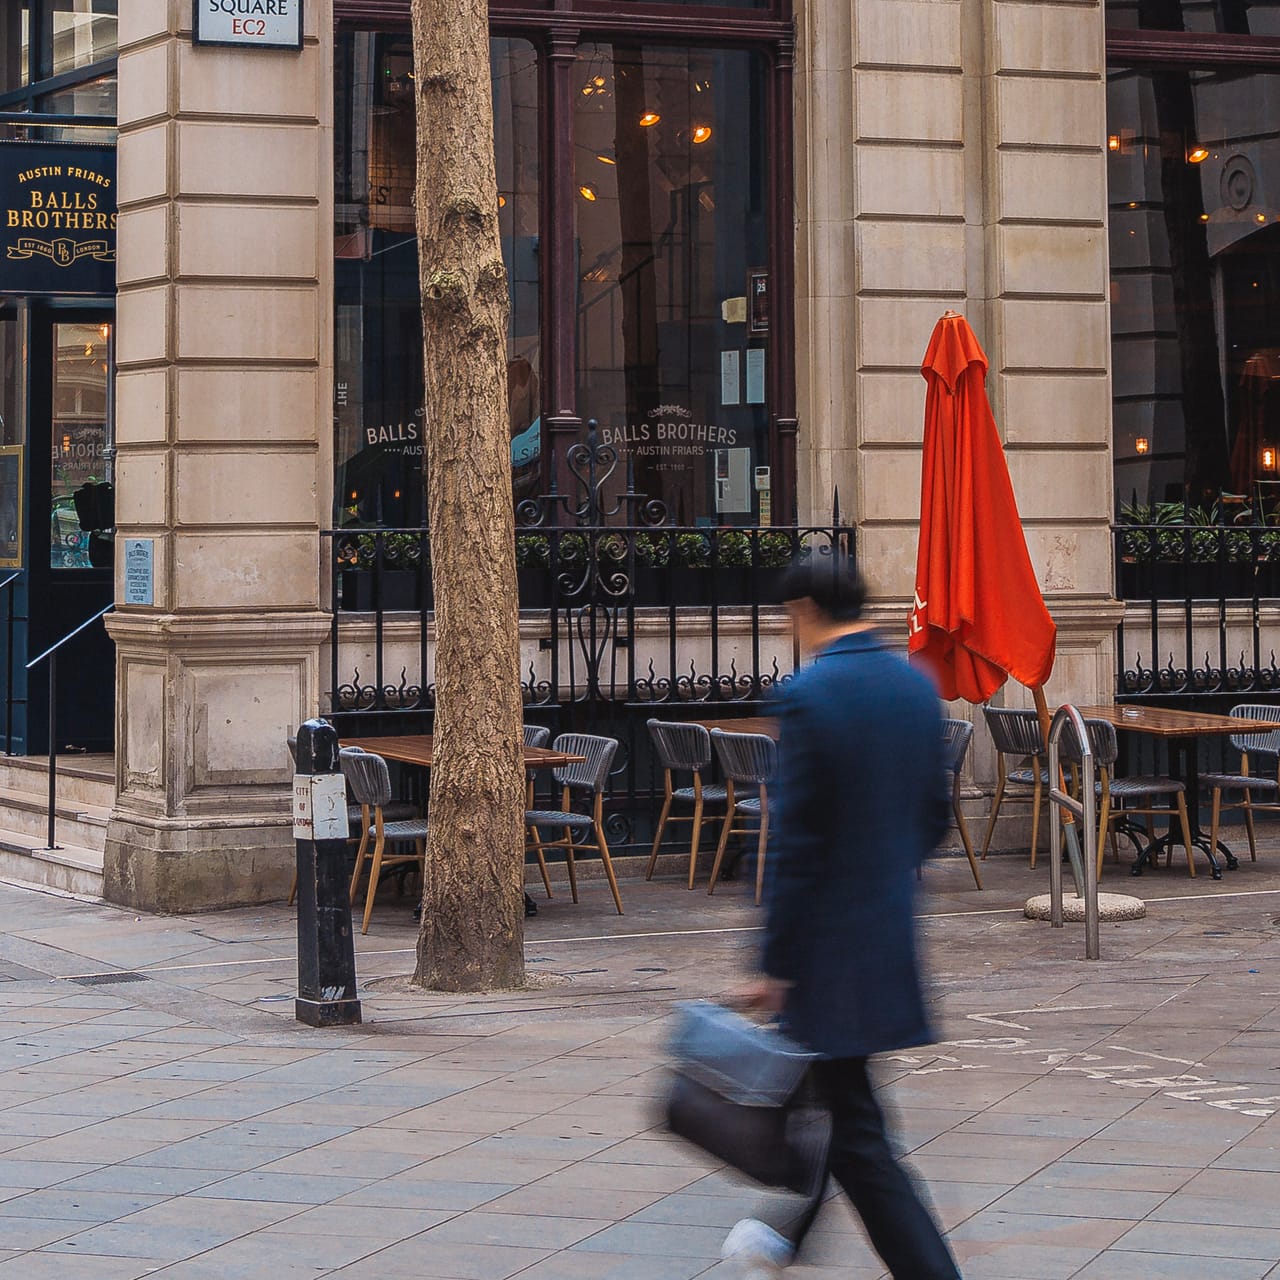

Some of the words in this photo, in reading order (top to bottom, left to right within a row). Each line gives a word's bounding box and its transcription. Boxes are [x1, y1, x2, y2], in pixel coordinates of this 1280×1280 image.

[232, 19, 266, 36] EC2
[18, 166, 62, 183] AUSTIN
[67, 166, 111, 188] FRIARS
[30, 190, 97, 210] BALLS
[7, 210, 118, 230] BROTHERS
[76, 245, 100, 254] LONDON
[337, 381, 348, 407] THE
[366, 423, 418, 445] BALLS
[602, 423, 650, 445] BALLS
[657, 423, 738, 445] BROTHERS
[636, 445, 670, 456] AUSTIN
[672, 446, 704, 456] FRIARS
